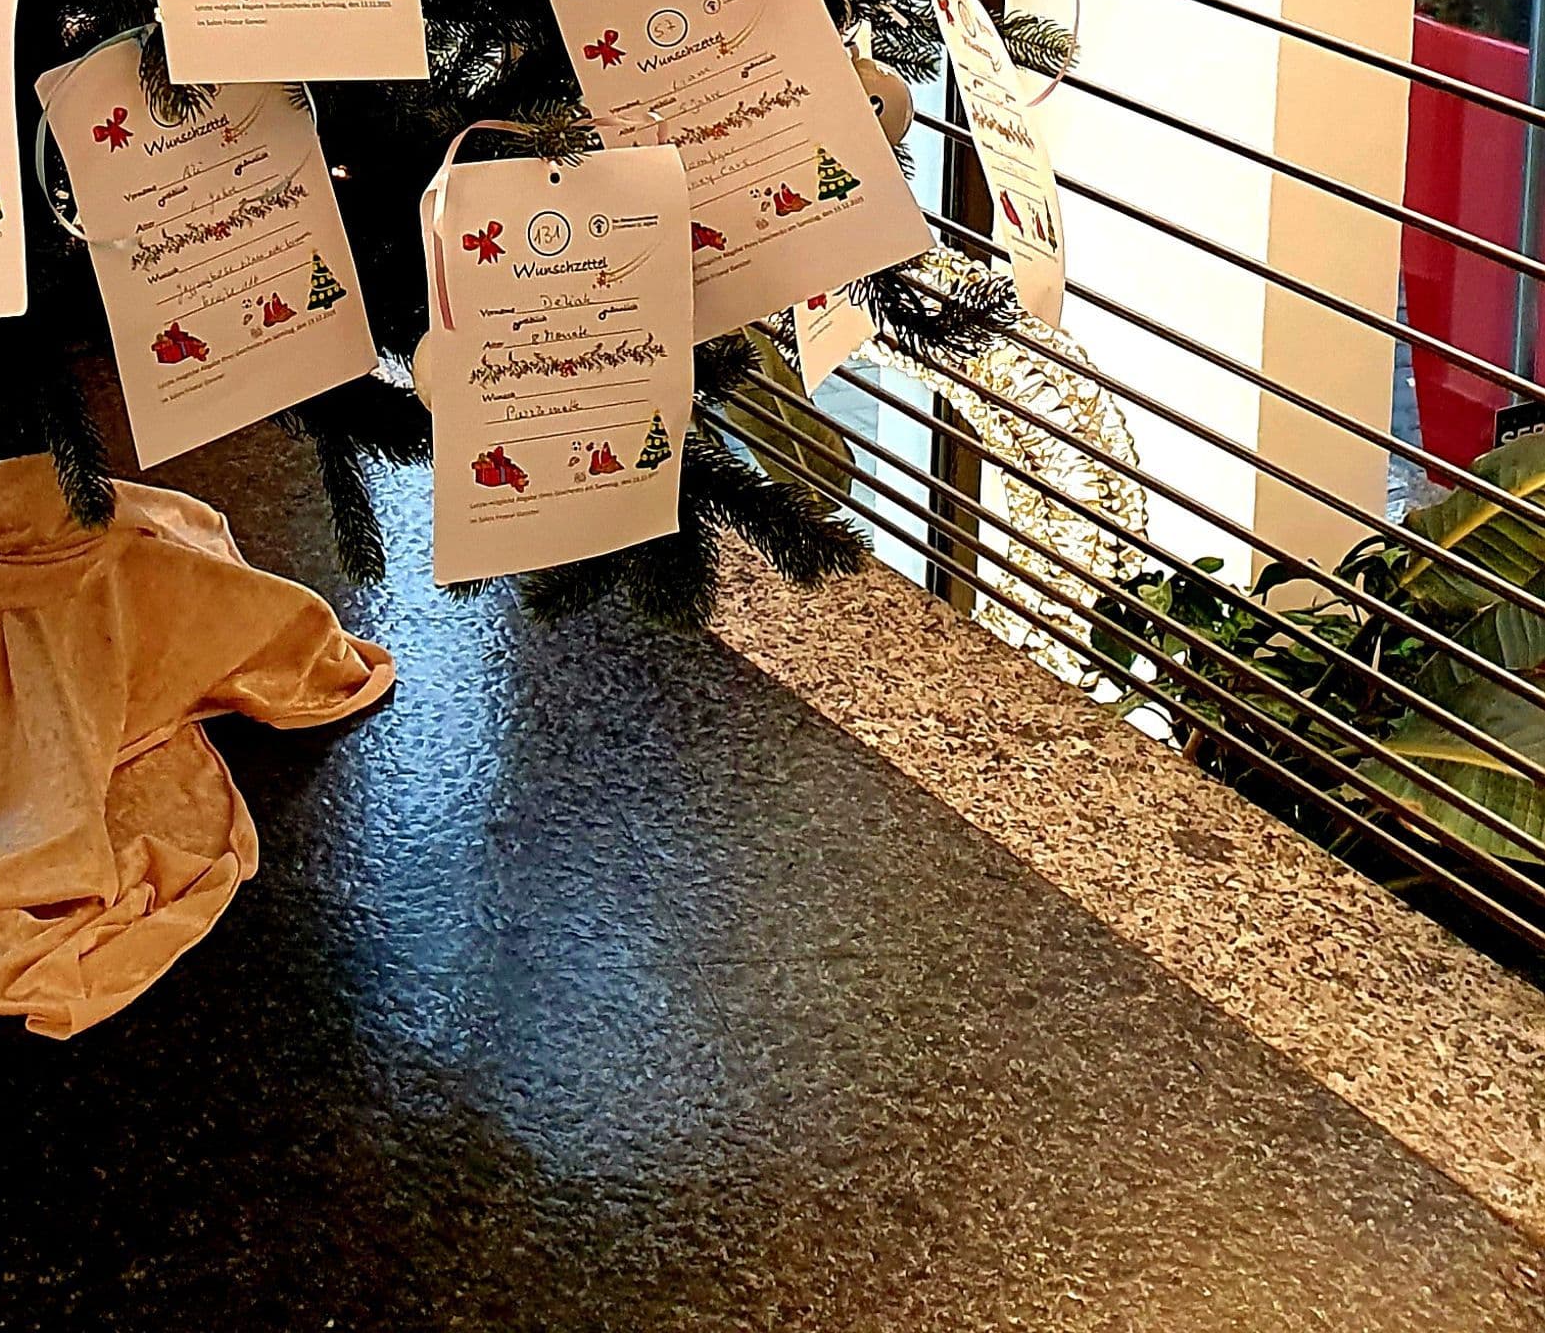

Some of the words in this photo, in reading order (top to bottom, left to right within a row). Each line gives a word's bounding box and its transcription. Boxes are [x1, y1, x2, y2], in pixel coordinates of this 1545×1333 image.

[637, 32, 725, 73] Wunschzettel
[143, 114, 231, 157] Wunschzettel
[513, 256, 609, 280] Wunschzettel
